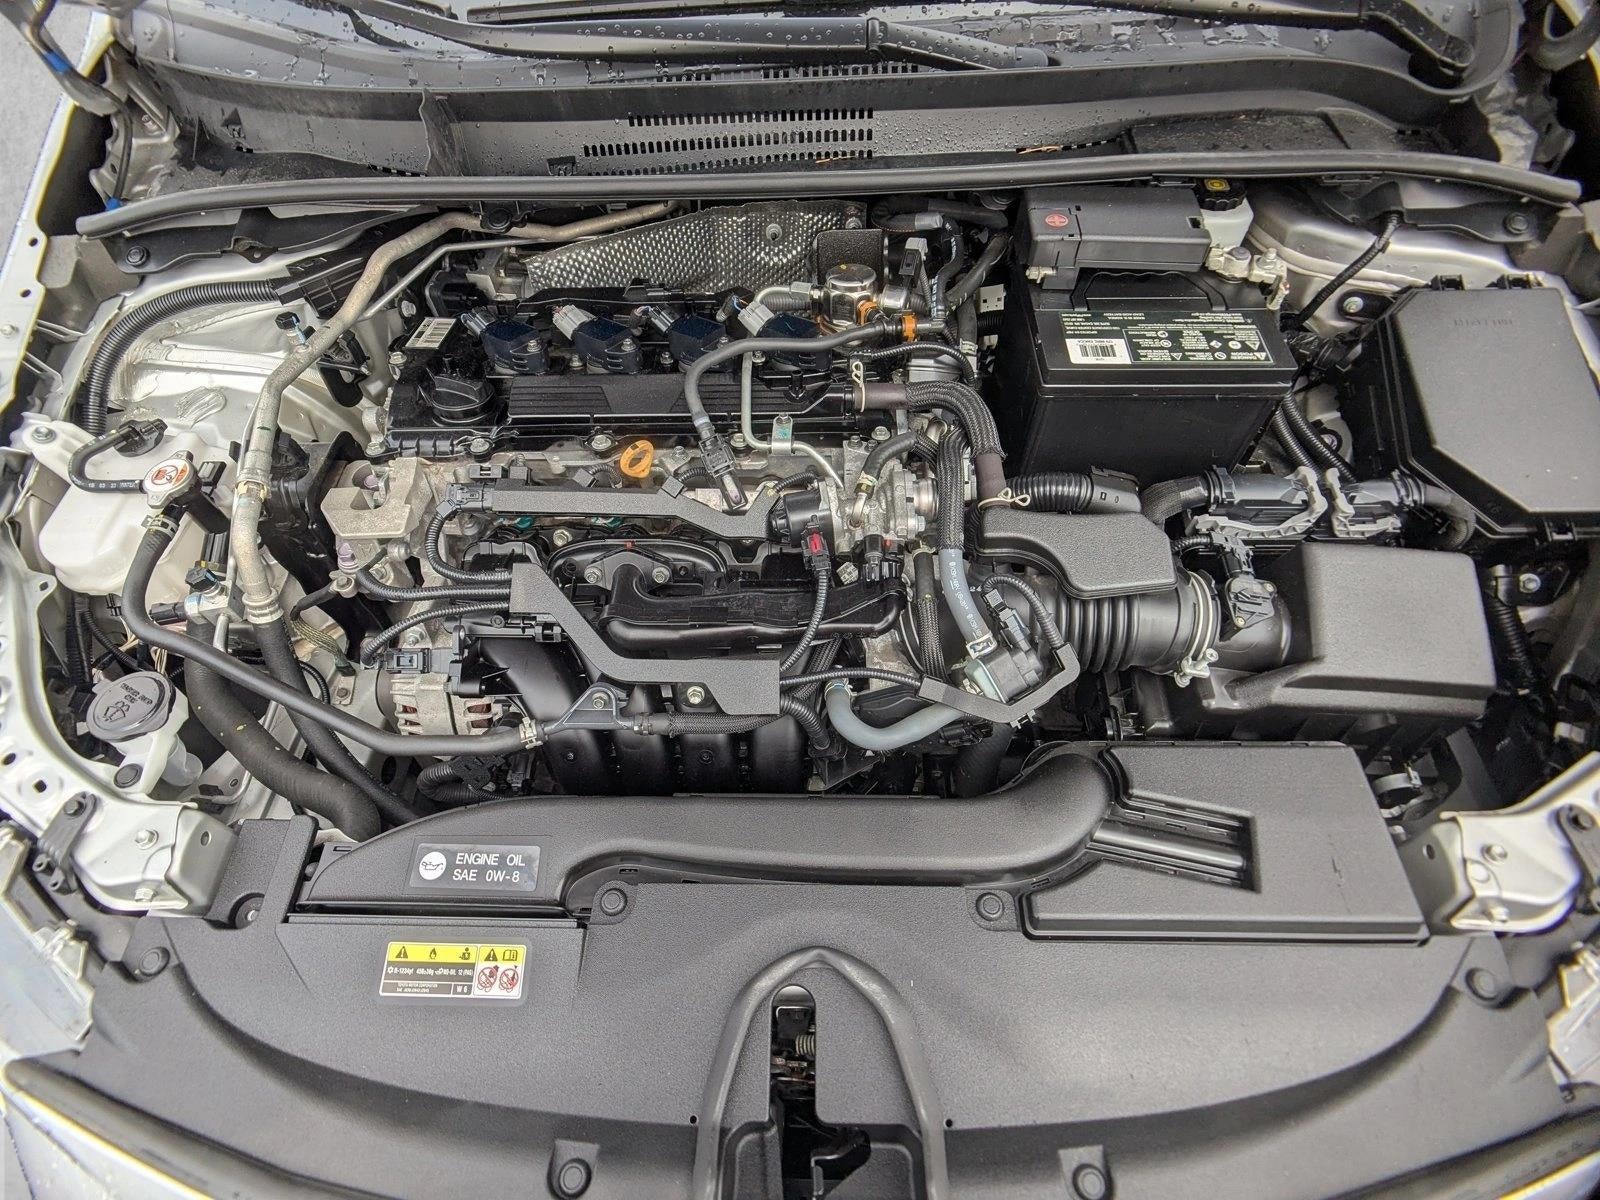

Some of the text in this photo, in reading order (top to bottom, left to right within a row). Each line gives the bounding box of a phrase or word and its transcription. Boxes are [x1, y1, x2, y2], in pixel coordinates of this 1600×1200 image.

[456, 852, 526, 866] ENGINE OIL
[452, 868, 520, 882] SAE 0W-8
